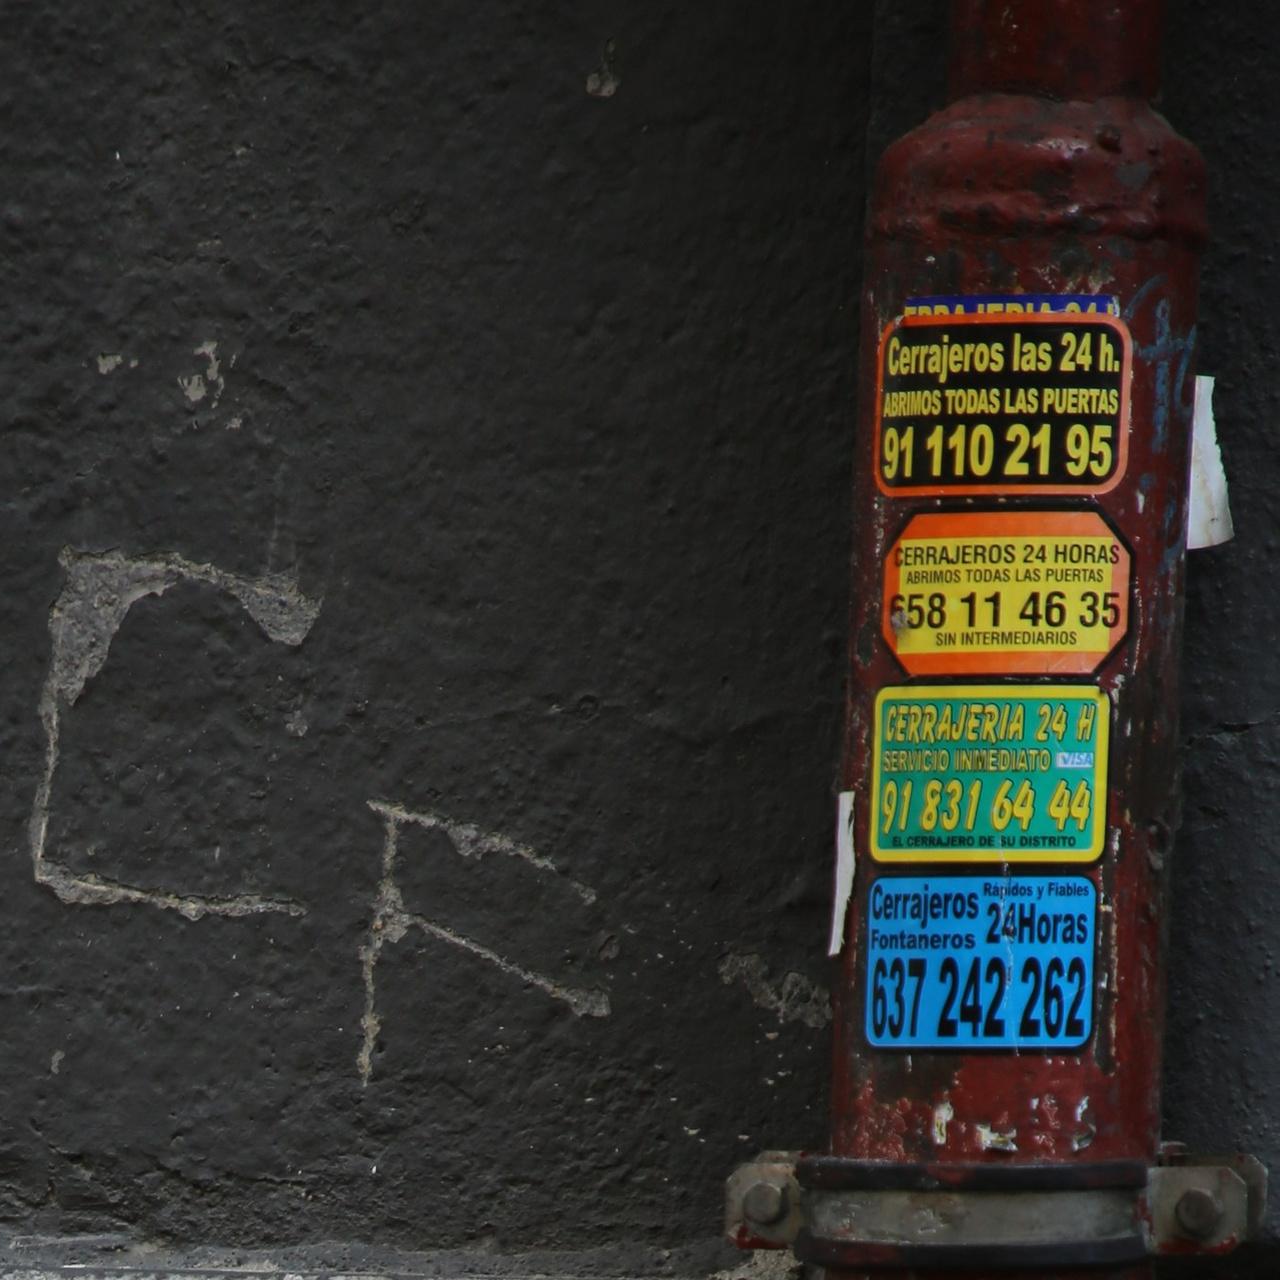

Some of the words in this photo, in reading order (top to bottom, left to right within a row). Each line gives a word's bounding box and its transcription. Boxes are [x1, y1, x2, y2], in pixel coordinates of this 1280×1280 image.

[888, 335, 1004, 383] Cerrajeros
[1013, 333, 1052, 372] las
[1060, 333, 1091, 372] 24
[1099, 334, 1120, 372] h.
[883, 389, 941, 417] ABRIMOS
[945, 389, 1000, 415] TODAS
[1004, 388, 1039, 414] LAS
[1043, 388, 1118, 415] PUERTAS
[883, 426, 914, 479] 91
[926, 424, 994, 477] 110
[1003, 423, 1051, 475] 21
[1066, 424, 1112, 476] 95
[894, 544, 1015, 567] CERRAJEROS
[1023, 545, 1047, 563] 24
[1054, 544, 1120, 564] HORAS
[906, 569, 961, 584] ABRIMOS
[965, 569, 1011, 583] TODAS
[1015, 568, 1041, 583] LAS
[1045, 568, 1104, 582] PUERTAS
[960, 591, 1001, 627] 11
[1020, 591, 1067, 627] 46
[1079, 591, 1120, 628] 35
[936, 632, 956, 646] SIN
[961, 631, 1077, 645] INTERMEDIARIOS
[885, 703, 1025, 744] CERRAJERIA
[1036, 703, 1067, 741] 24
[1076, 704, 1095, 741] H
[883, 750, 950, 772] SERVICIO
[955, 749, 1051, 772] INMEDIATO
[1060, 753, 1093, 766] VISA
[882, 779, 913, 835] 91
[921, 779, 983, 831] 831
[991, 779, 1036, 831] 64
[1048, 779, 1092, 831] 44
[892, 836, 905, 847] EL
[906, 836, 975, 847] CERRAJERO
[979, 836, 995, 847] DE
[1000, 836, 1015, 847] SU
[1020, 835, 1077, 847] DISTRITO
[1037, 886, 1044, 900] y
[1048, 882, 1089, 897] Fiables
[873, 884, 979, 928] Cerrajeros
[871, 929, 976, 950] Fontaneros
[873, 957, 927, 1039] 637
[937, 957, 1007, 1038] 242
[1019, 957, 1086, 1038] 262
